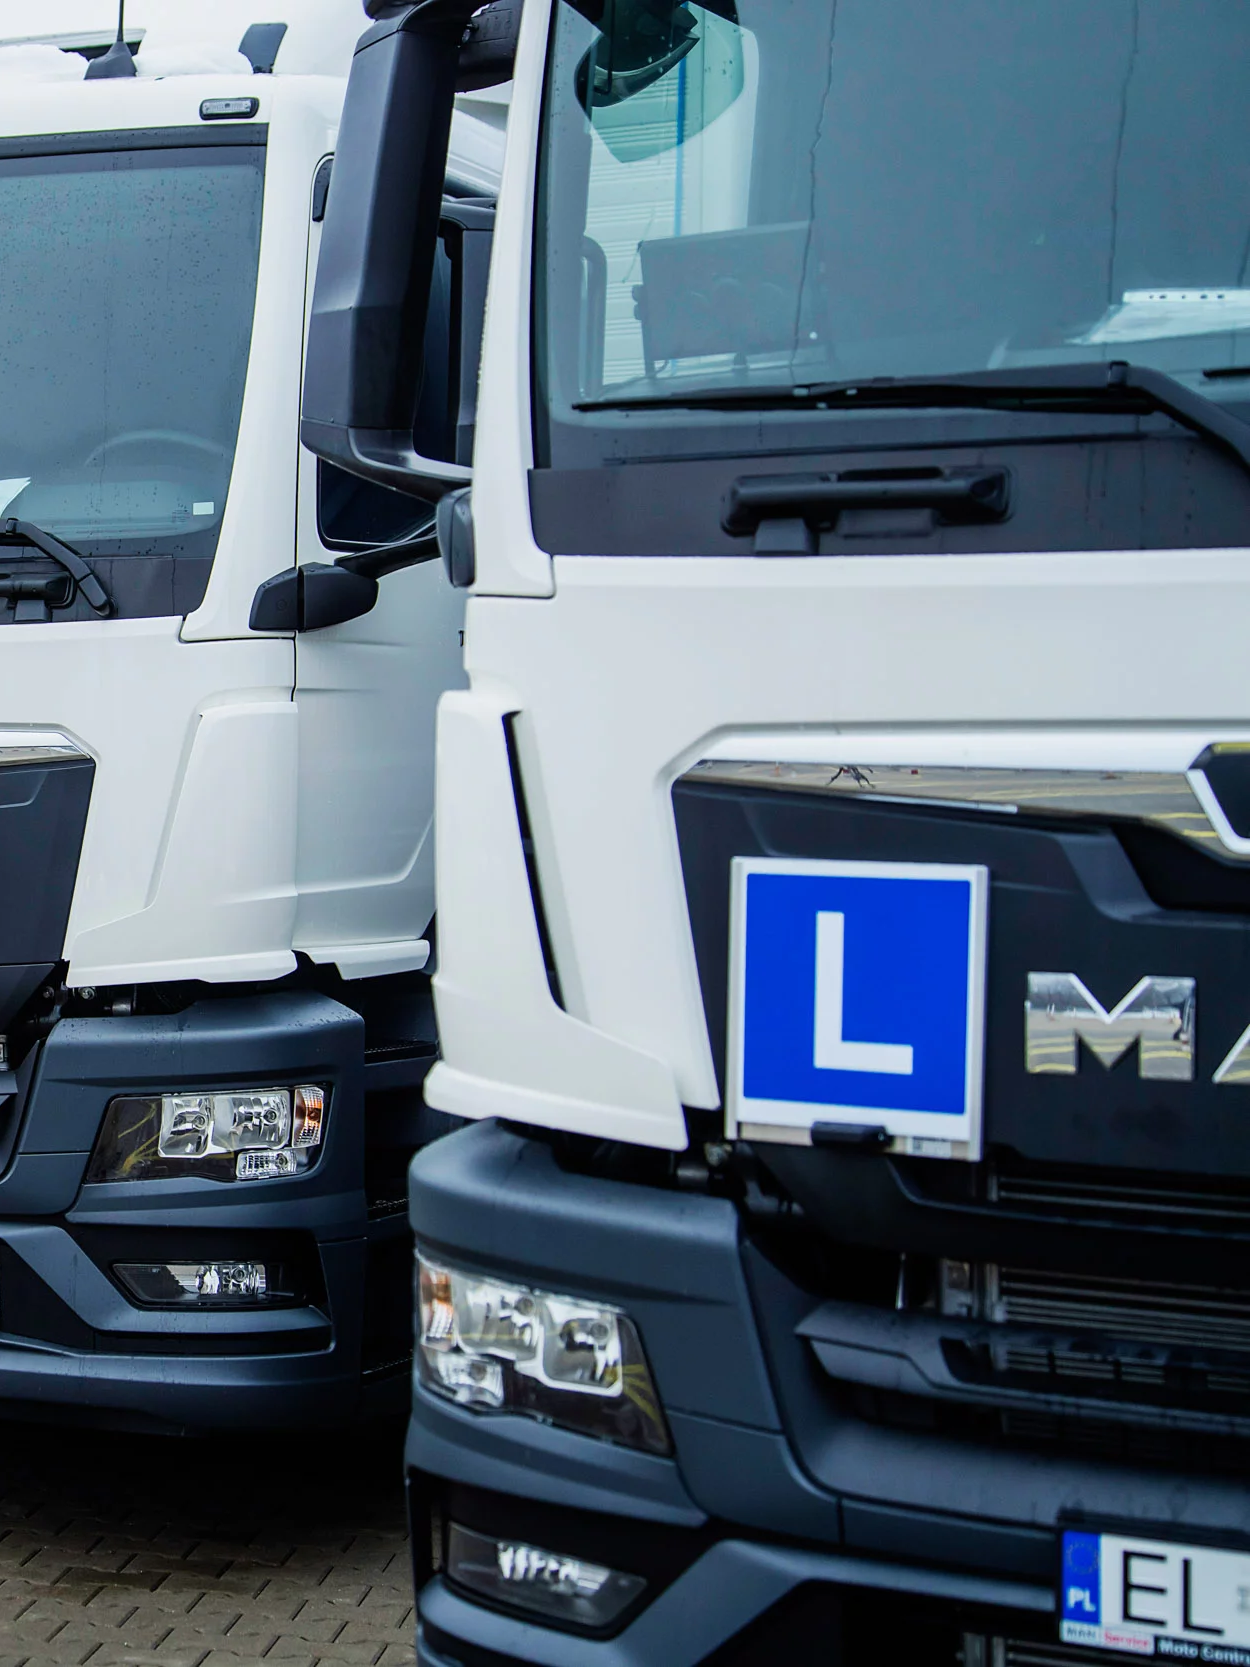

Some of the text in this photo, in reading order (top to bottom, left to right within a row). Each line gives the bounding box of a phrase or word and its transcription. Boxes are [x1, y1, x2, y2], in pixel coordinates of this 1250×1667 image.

[814, 911, 914, 1075] L
[1023, 972, 1250, 1084] M
[1068, 1586, 1097, 1613] PL
[1122, 1549, 1225, 1638] EL
[1159, 1639, 1199, 1658] Moto
